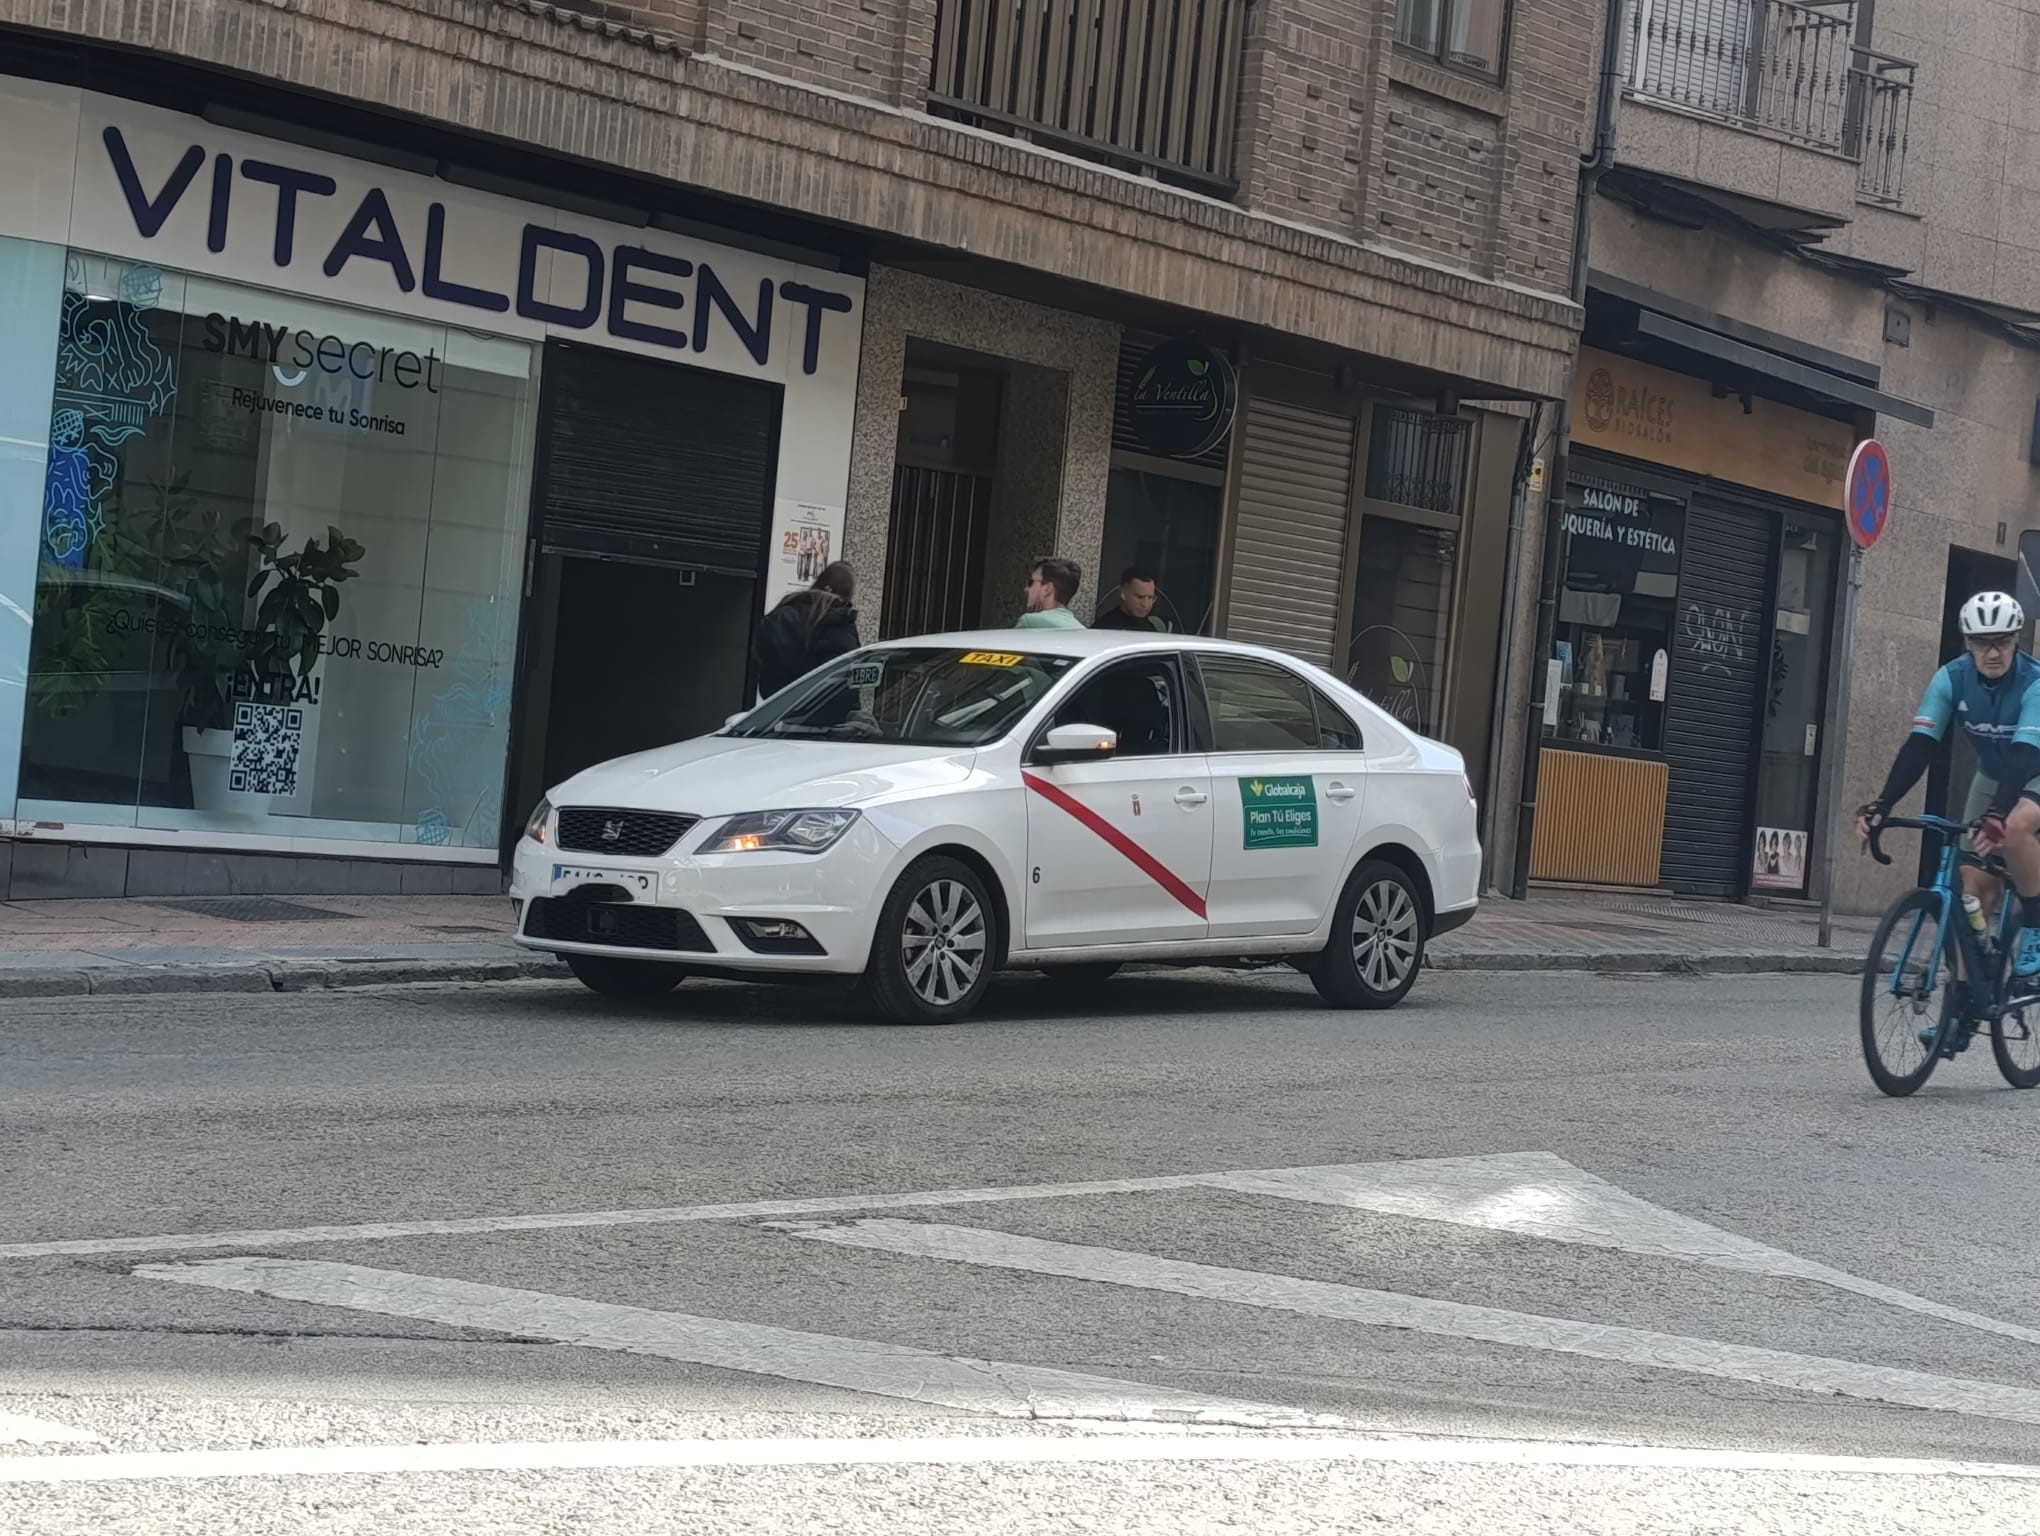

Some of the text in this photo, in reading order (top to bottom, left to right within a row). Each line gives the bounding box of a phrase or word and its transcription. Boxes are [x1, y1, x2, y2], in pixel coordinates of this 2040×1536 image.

[102, 126, 852, 375] VITALDENT
[231, 387, 406, 435] Rejuvenece tu Sonrisa
[1583, 487, 1640, 518] SALÓN DE
[783, 531, 799, 549] 25
[1616, 524, 1626, 543] Y
[1627, 527, 1676, 555] ESTÉTICA
[185, 622, 268, 650] conseg
[368, 641, 444, 669] SONRISA?
[971, 653, 1018, 665] TAXI
[1264, 783, 1307, 800] Globalcaja
[1250, 810, 1271, 824] Plan
[1285, 807, 1312, 826] Eliges
[1032, 866, 1041, 884] 6
